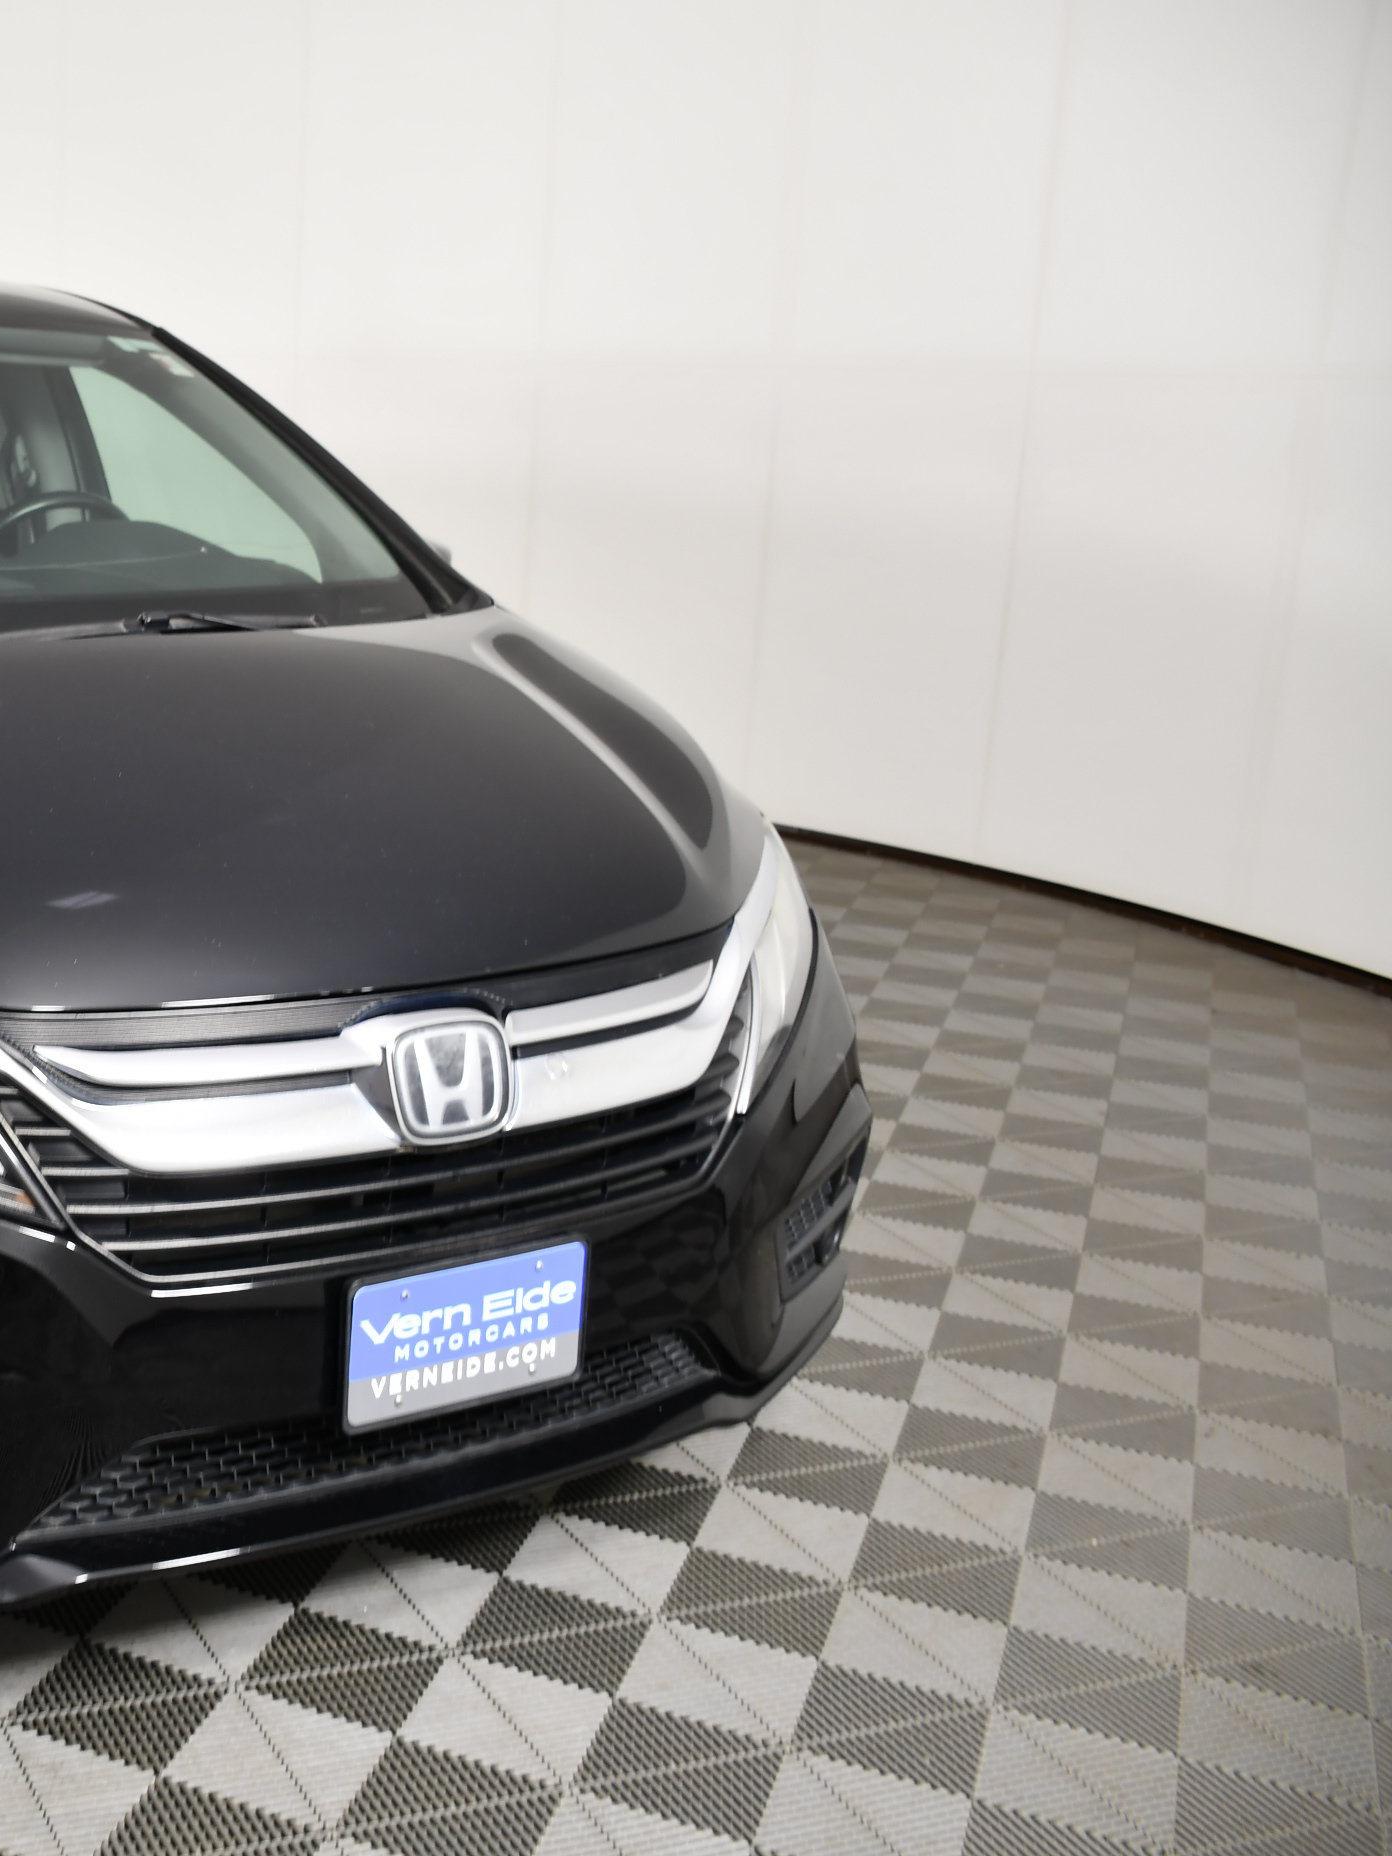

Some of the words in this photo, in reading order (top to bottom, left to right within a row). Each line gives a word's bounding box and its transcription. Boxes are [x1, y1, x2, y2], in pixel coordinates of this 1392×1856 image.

[360, 1303, 472, 1345] Vern
[394, 1312, 549, 1363] MOTORCARS
[371, 1337, 557, 1399] VERNEIDE.COM
